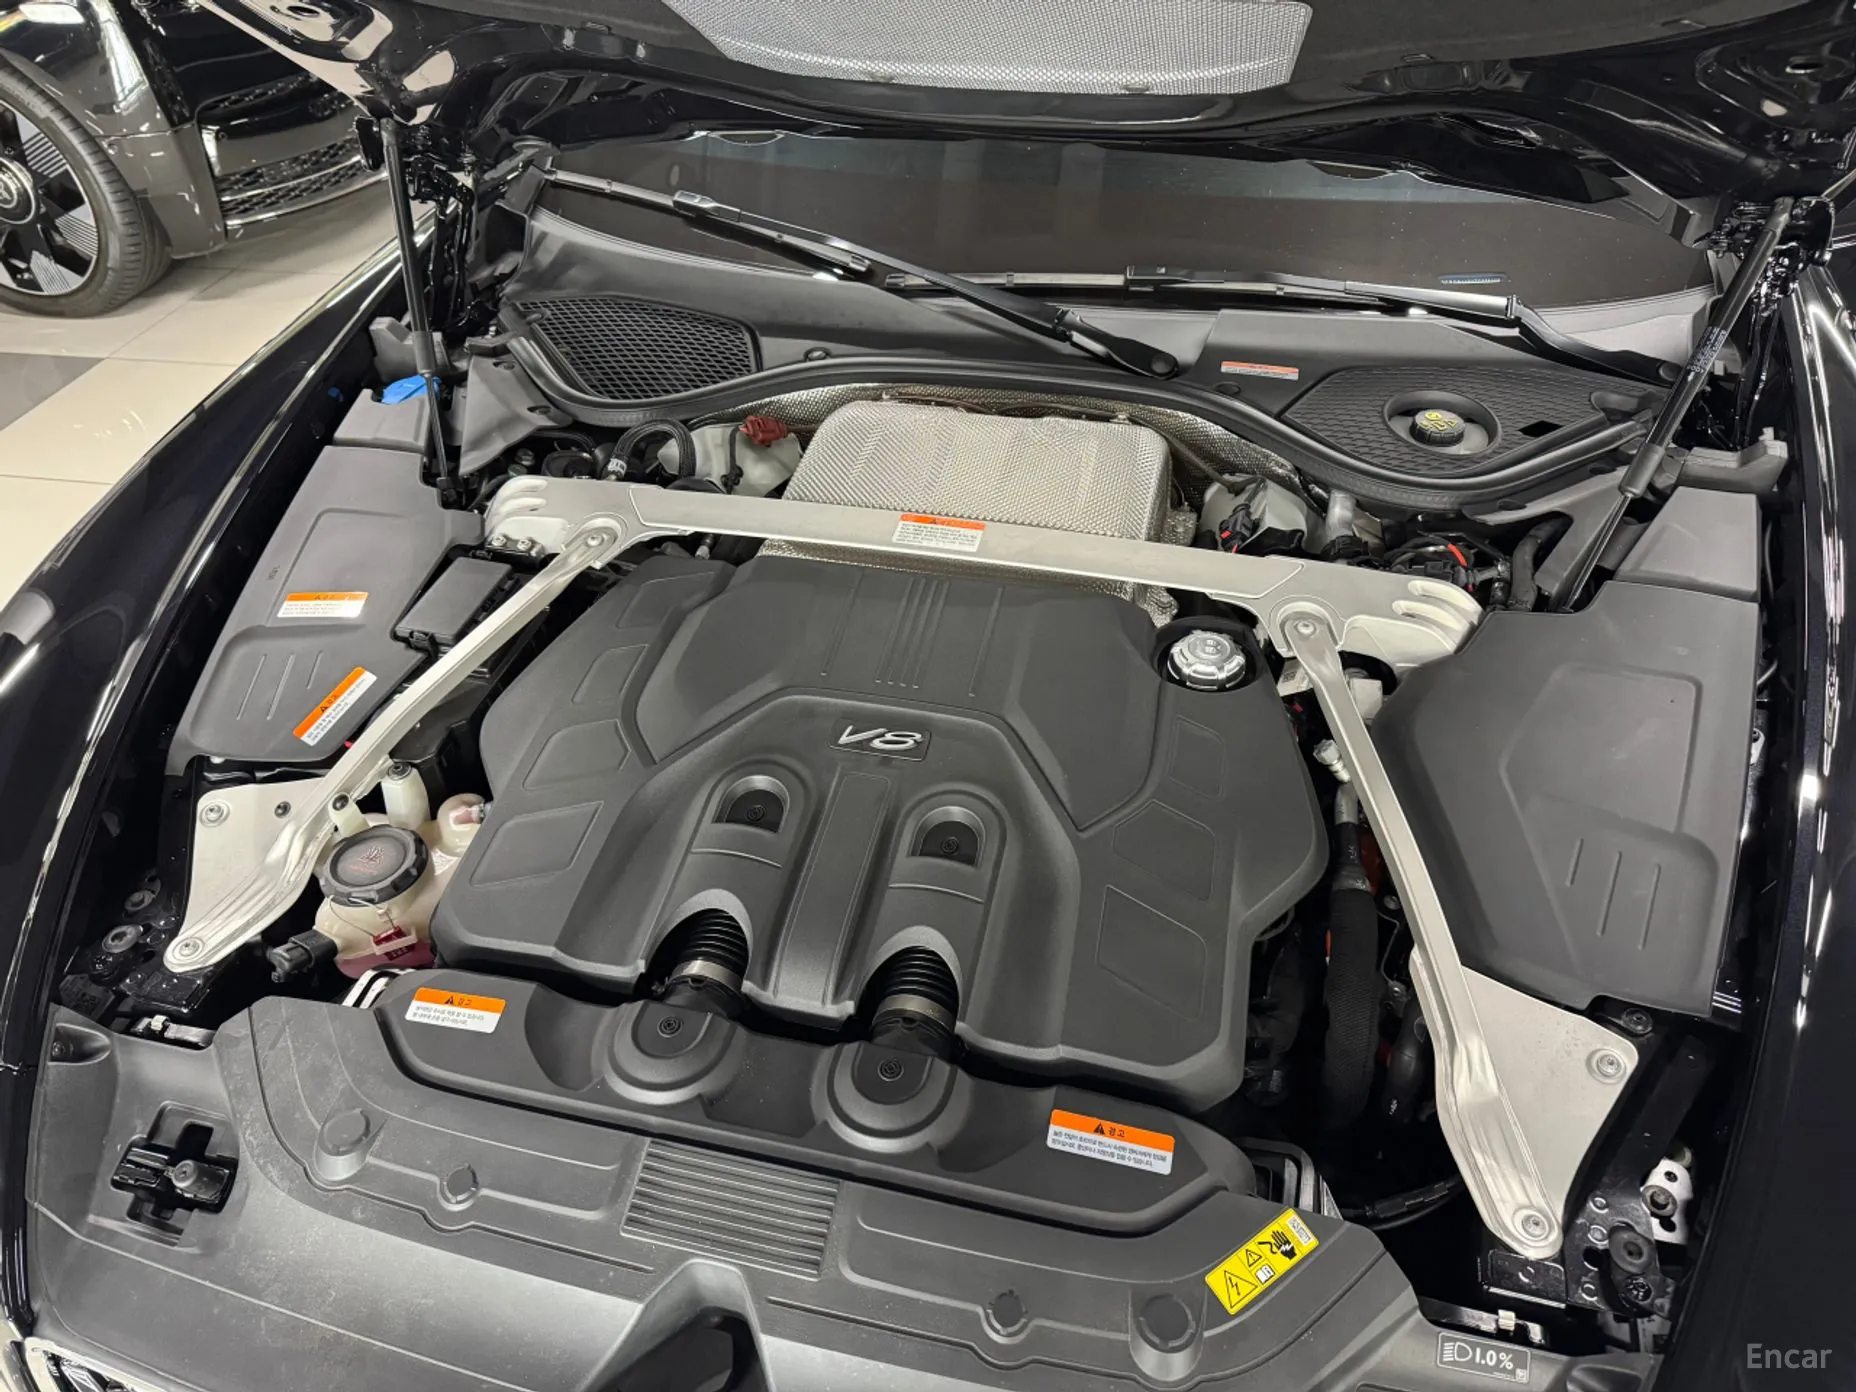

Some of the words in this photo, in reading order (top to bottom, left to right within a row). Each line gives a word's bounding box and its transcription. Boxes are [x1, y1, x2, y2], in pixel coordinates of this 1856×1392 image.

[838, 724, 923, 751] V8
[1108, 1127, 1126, 1138] 경고
[1475, 1347, 1514, 1370] 1.0%
